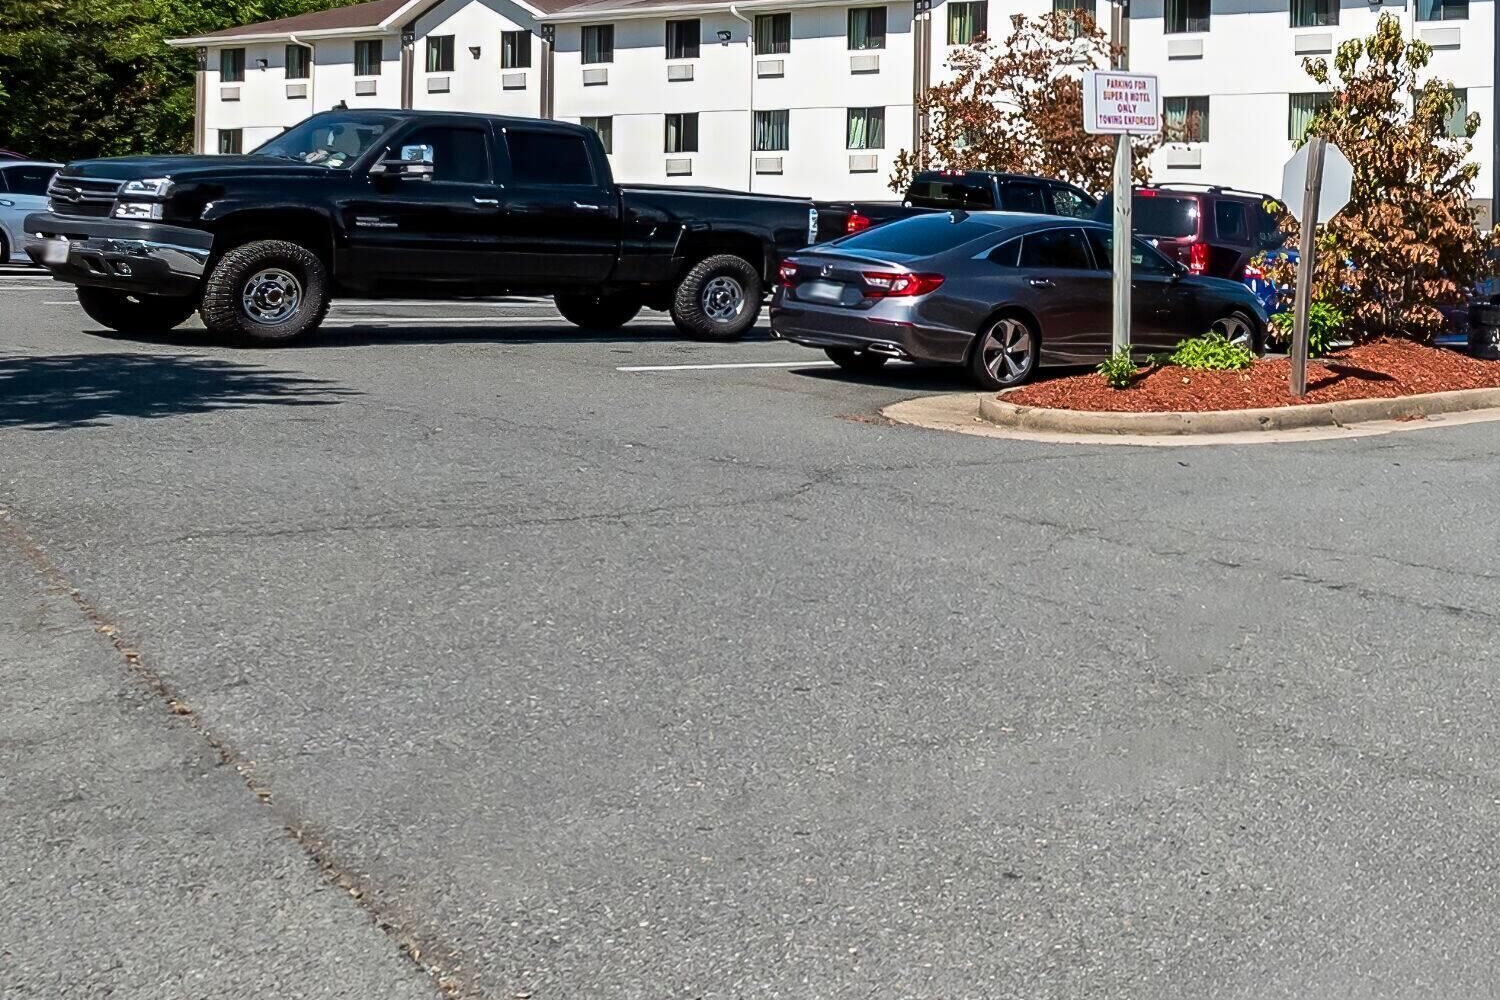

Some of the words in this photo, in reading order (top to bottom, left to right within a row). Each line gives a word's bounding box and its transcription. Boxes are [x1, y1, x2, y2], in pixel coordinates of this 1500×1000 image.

[1106, 78, 1133, 89] PARKING
[1134, 80, 1146, 90] FOR
[1103, 90, 1123, 101] SUPER
[1117, 103, 1137, 114] ONLY
[1099, 114, 1123, 125] TOWING
[1124, 115, 1156, 126] ENFORCED
